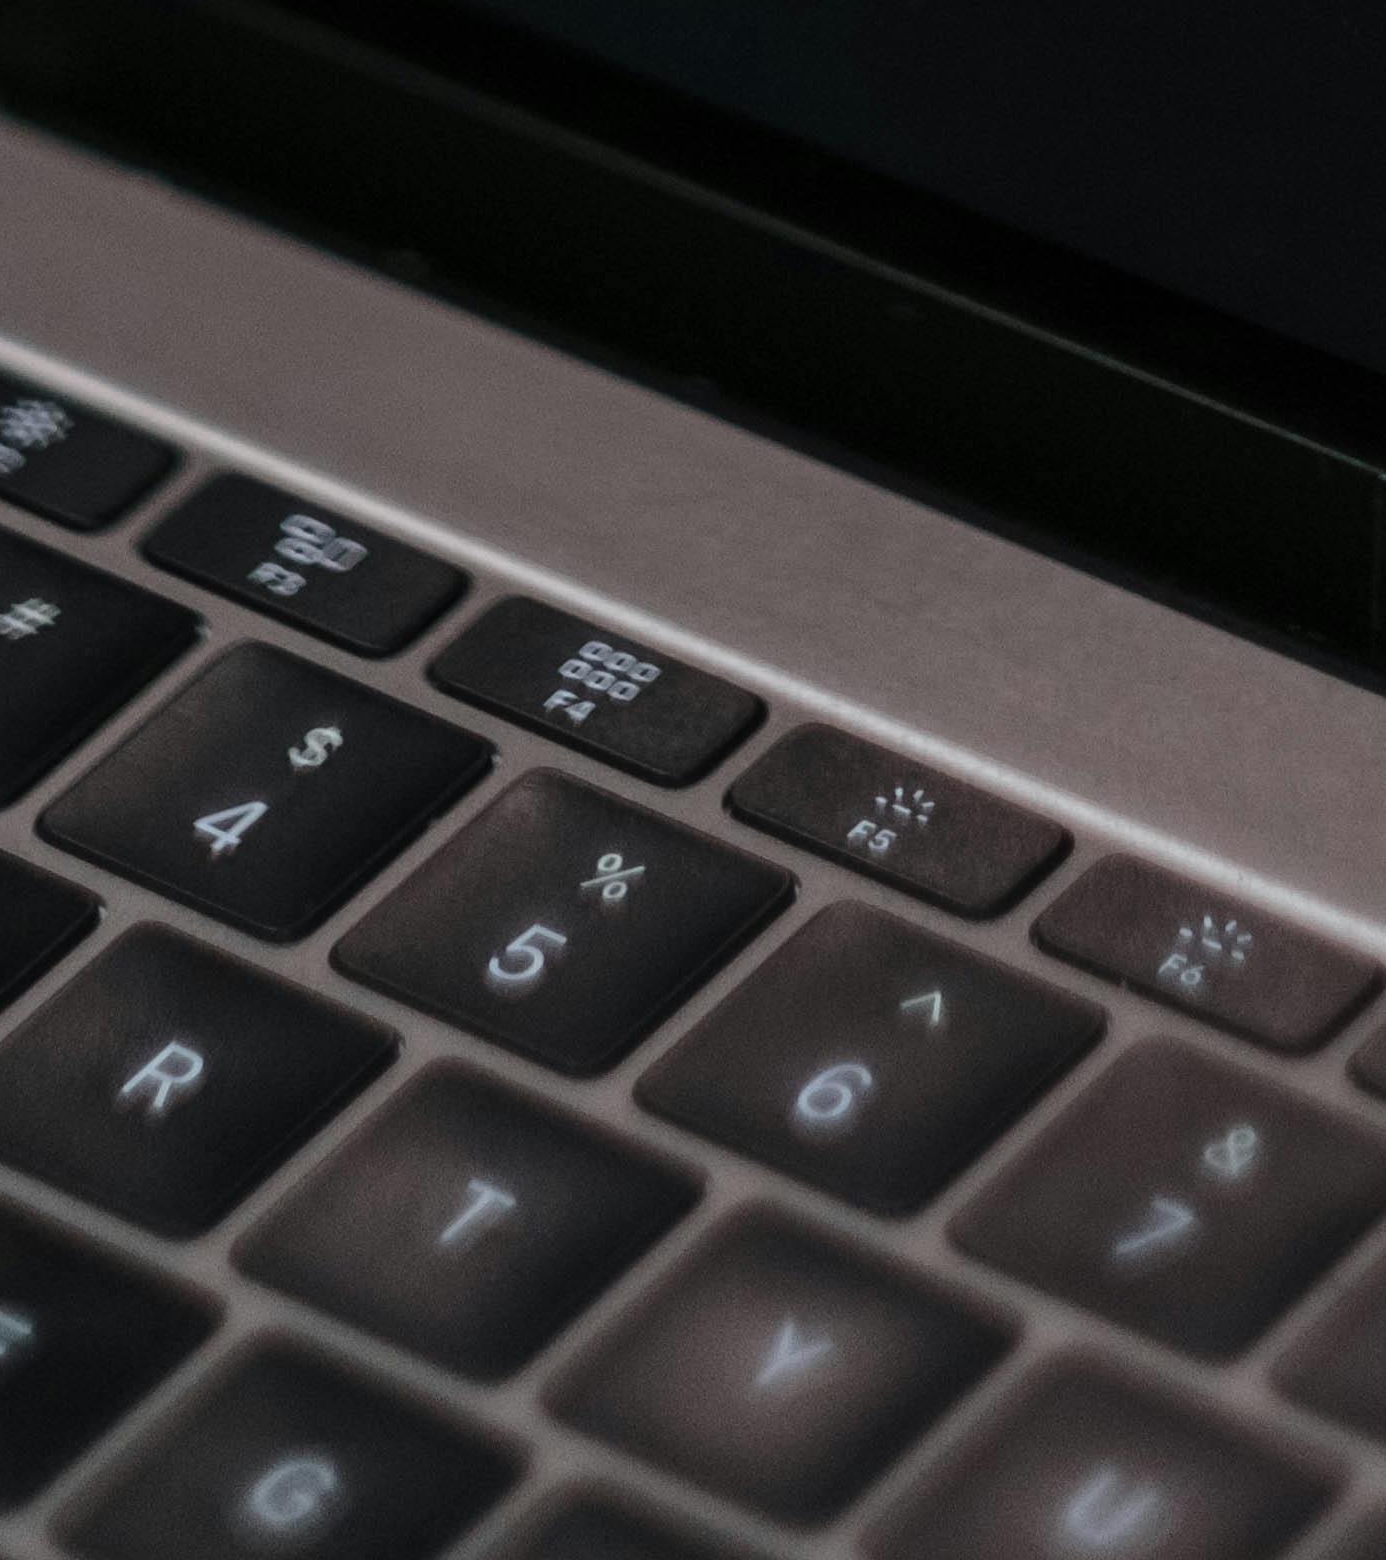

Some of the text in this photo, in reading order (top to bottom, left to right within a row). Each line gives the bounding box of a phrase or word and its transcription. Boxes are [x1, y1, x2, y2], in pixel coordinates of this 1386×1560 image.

[542, 688, 597, 727] F4
[287, 724, 344, 770] $
[192, 798, 269, 857] 4
[846, 818, 897, 852] F5
[579, 851, 647, 902] %
[485, 922, 569, 986] 5
[1156, 952, 1206, 987] F6
[118, 1039, 206, 1113] R
[793, 1060, 875, 1125] 6
[438, 1177, 517, 1244] T
[1112, 1194, 1199, 1261] 7
[753, 1319, 836, 1390] Y
[240, 1453, 341, 1536] G
